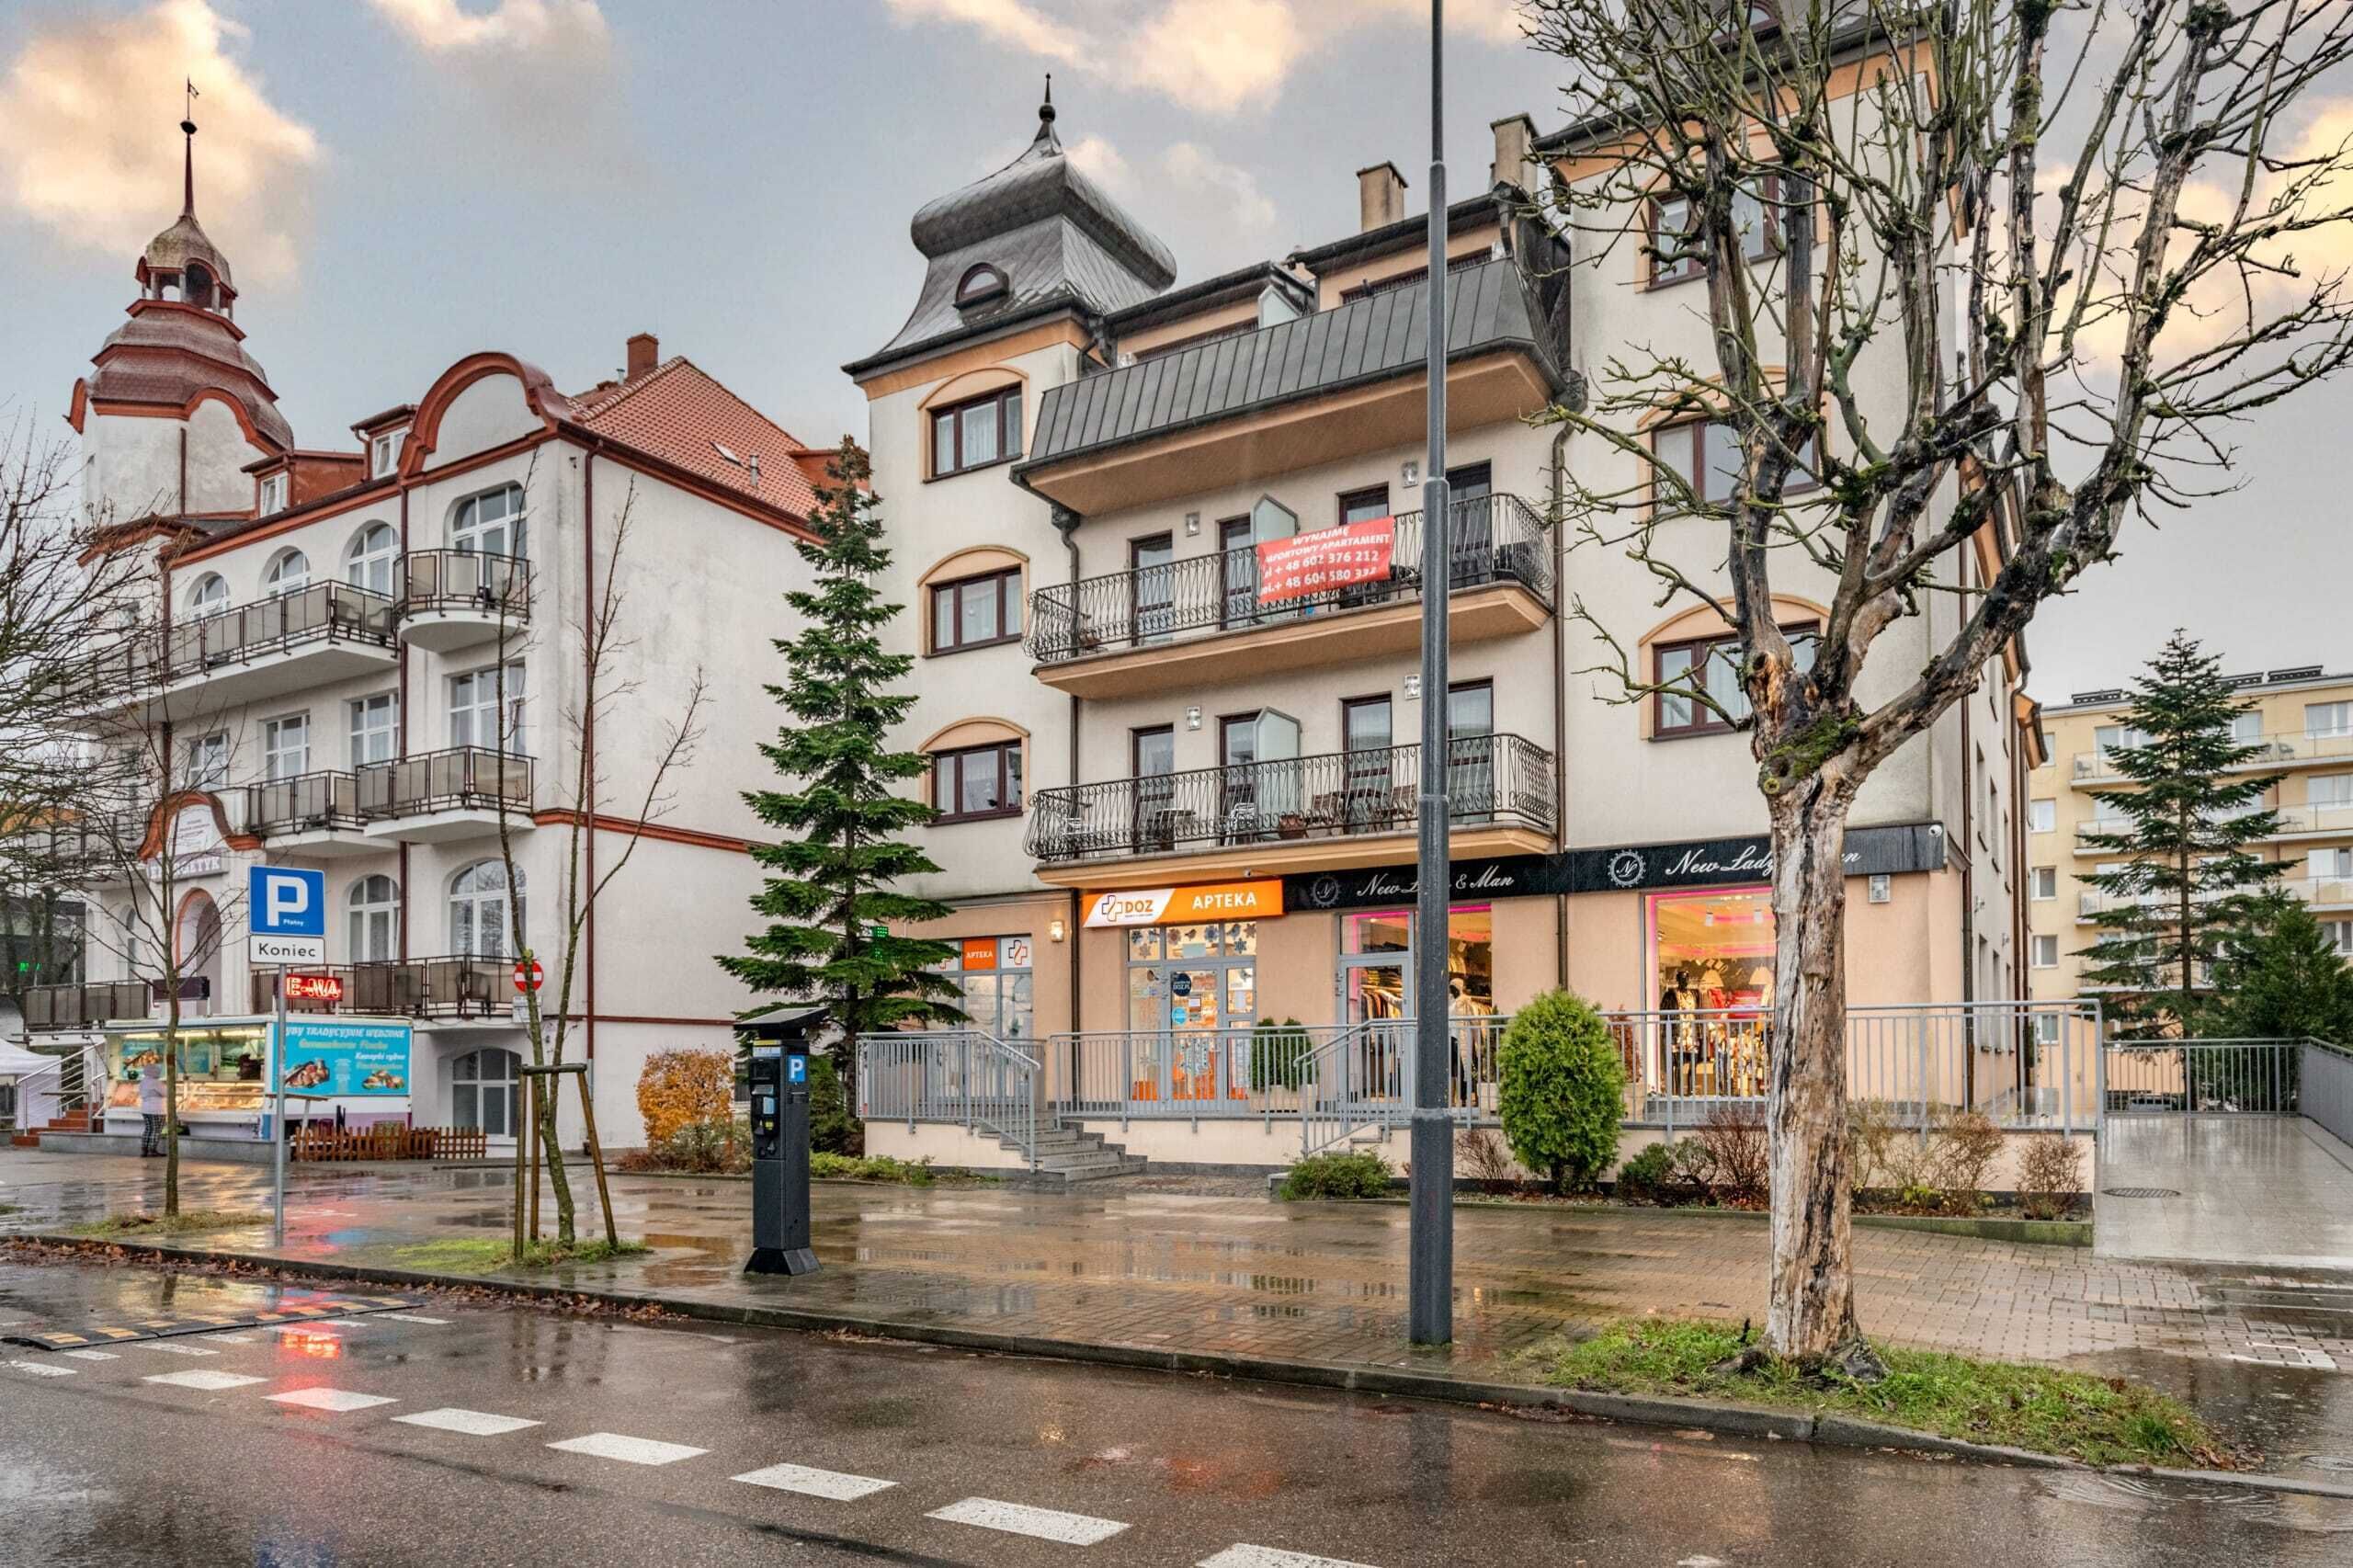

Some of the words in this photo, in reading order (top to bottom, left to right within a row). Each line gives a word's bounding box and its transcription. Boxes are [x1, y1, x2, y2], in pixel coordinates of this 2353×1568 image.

[1321, 534, 1390, 550] APARTAMENT
[1286, 560, 1300, 572] 48
[1302, 554, 1324, 567] 602
[1328, 551, 1351, 563] 376
[1356, 551, 1379, 562] 212
[1286, 576, 1301, 588] 48
[1329, 569, 1351, 581] 580
[1665, 849, 1720, 874] New
[1721, 845, 1774, 876] Lady
[1357, 873, 1400, 896] New
[1455, 874, 1467, 889] &
[1470, 866, 1515, 888] Man
[267, 875, 309, 926] P
[1125, 900, 1154, 913] DOZ
[1192, 892, 1257, 910] APTEKA
[258, 943, 316, 958] Koniec
[966, 950, 994, 960] APTEKA
[286, 1027, 304, 1037] YBY
[790, 1058, 804, 1079] P
